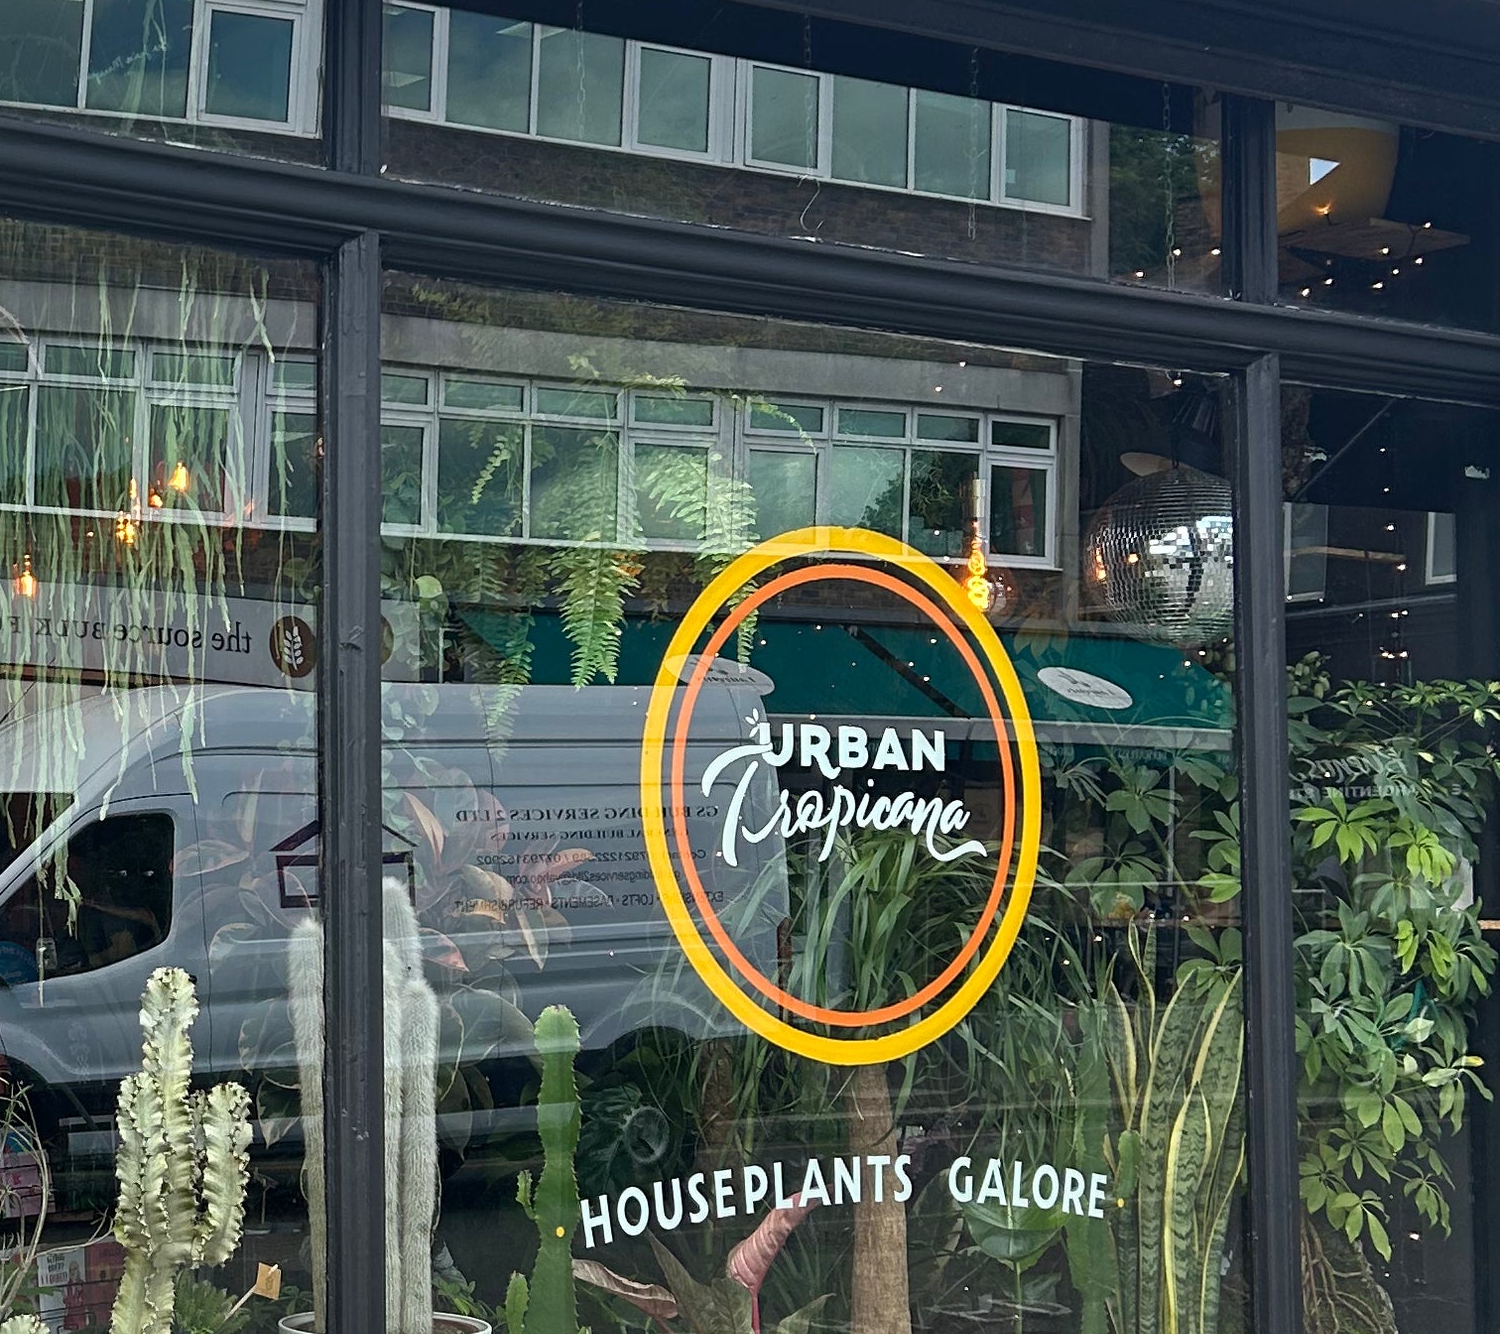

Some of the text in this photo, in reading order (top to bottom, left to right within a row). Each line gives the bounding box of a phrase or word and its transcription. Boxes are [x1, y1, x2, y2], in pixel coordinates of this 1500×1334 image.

[756, 719, 946, 779] URBAN
[701, 744, 988, 867] Tropicana
[579, 1153, 1109, 1248] HOUSEPLANTS GALORE
